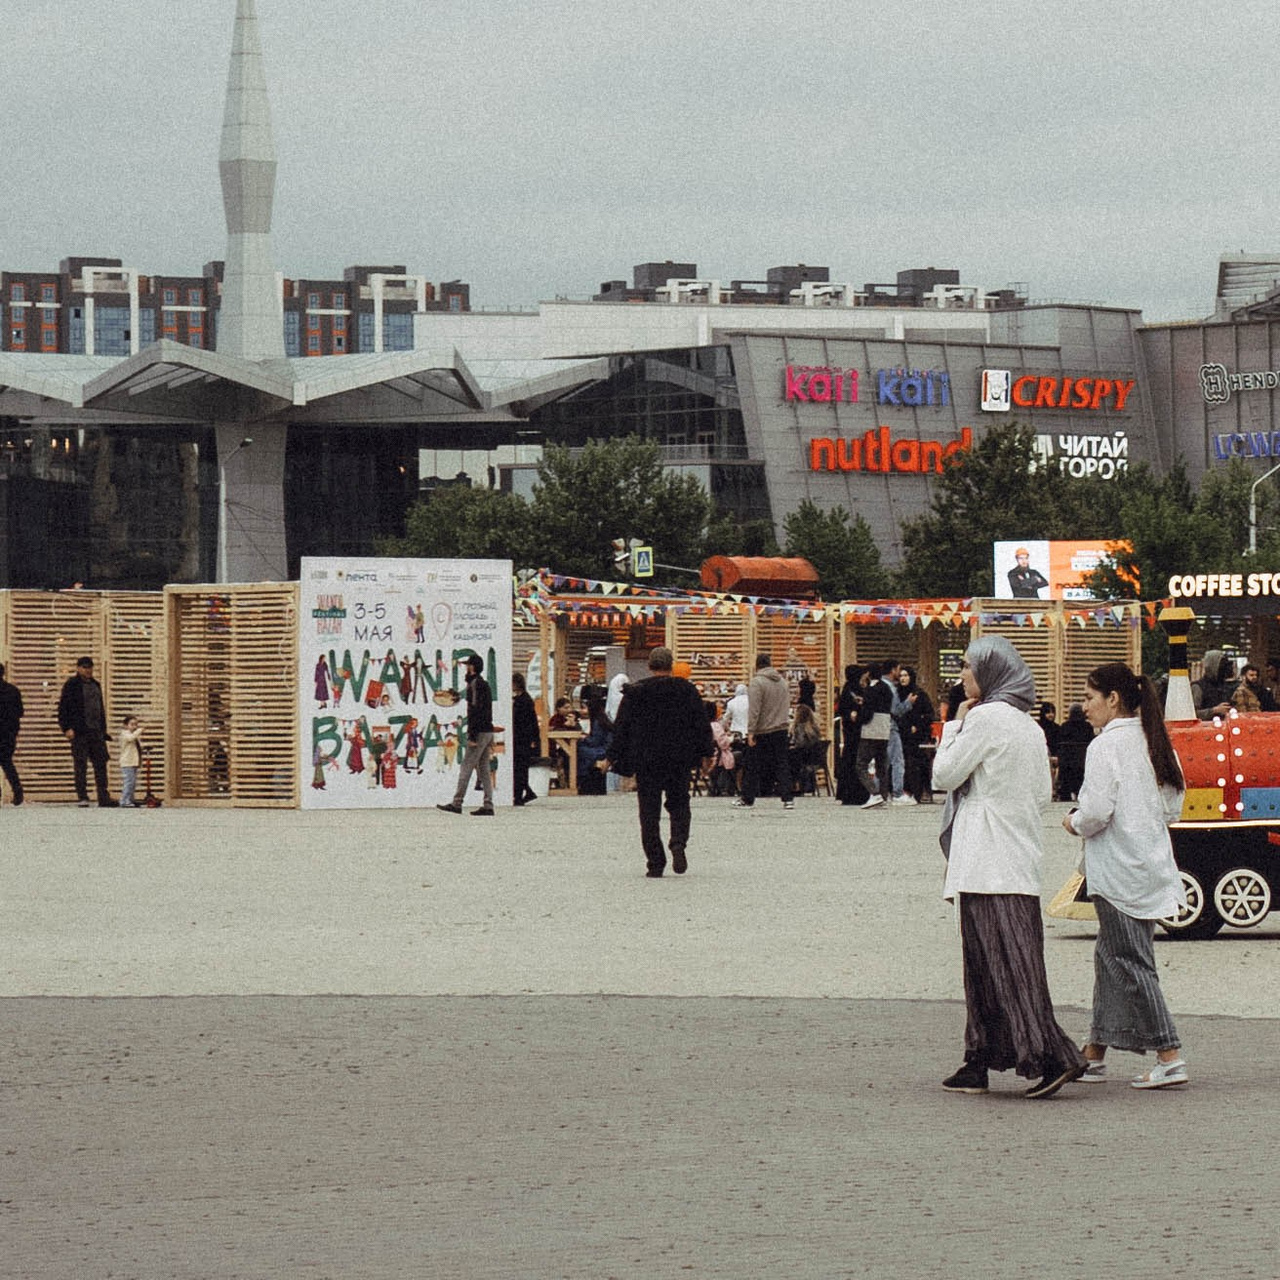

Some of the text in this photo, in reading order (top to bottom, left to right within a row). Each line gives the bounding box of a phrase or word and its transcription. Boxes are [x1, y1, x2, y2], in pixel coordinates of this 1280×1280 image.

[1011, 375, 1135, 410] CRISPY
[811, 426, 973, 474] nutland
[1059, 431, 1129, 457] ЧИТАЙ
[1168, 574, 1244, 598] COFFEE
[354, 603, 387, 619] 3-5
[354, 625, 393, 641] МАЯ
